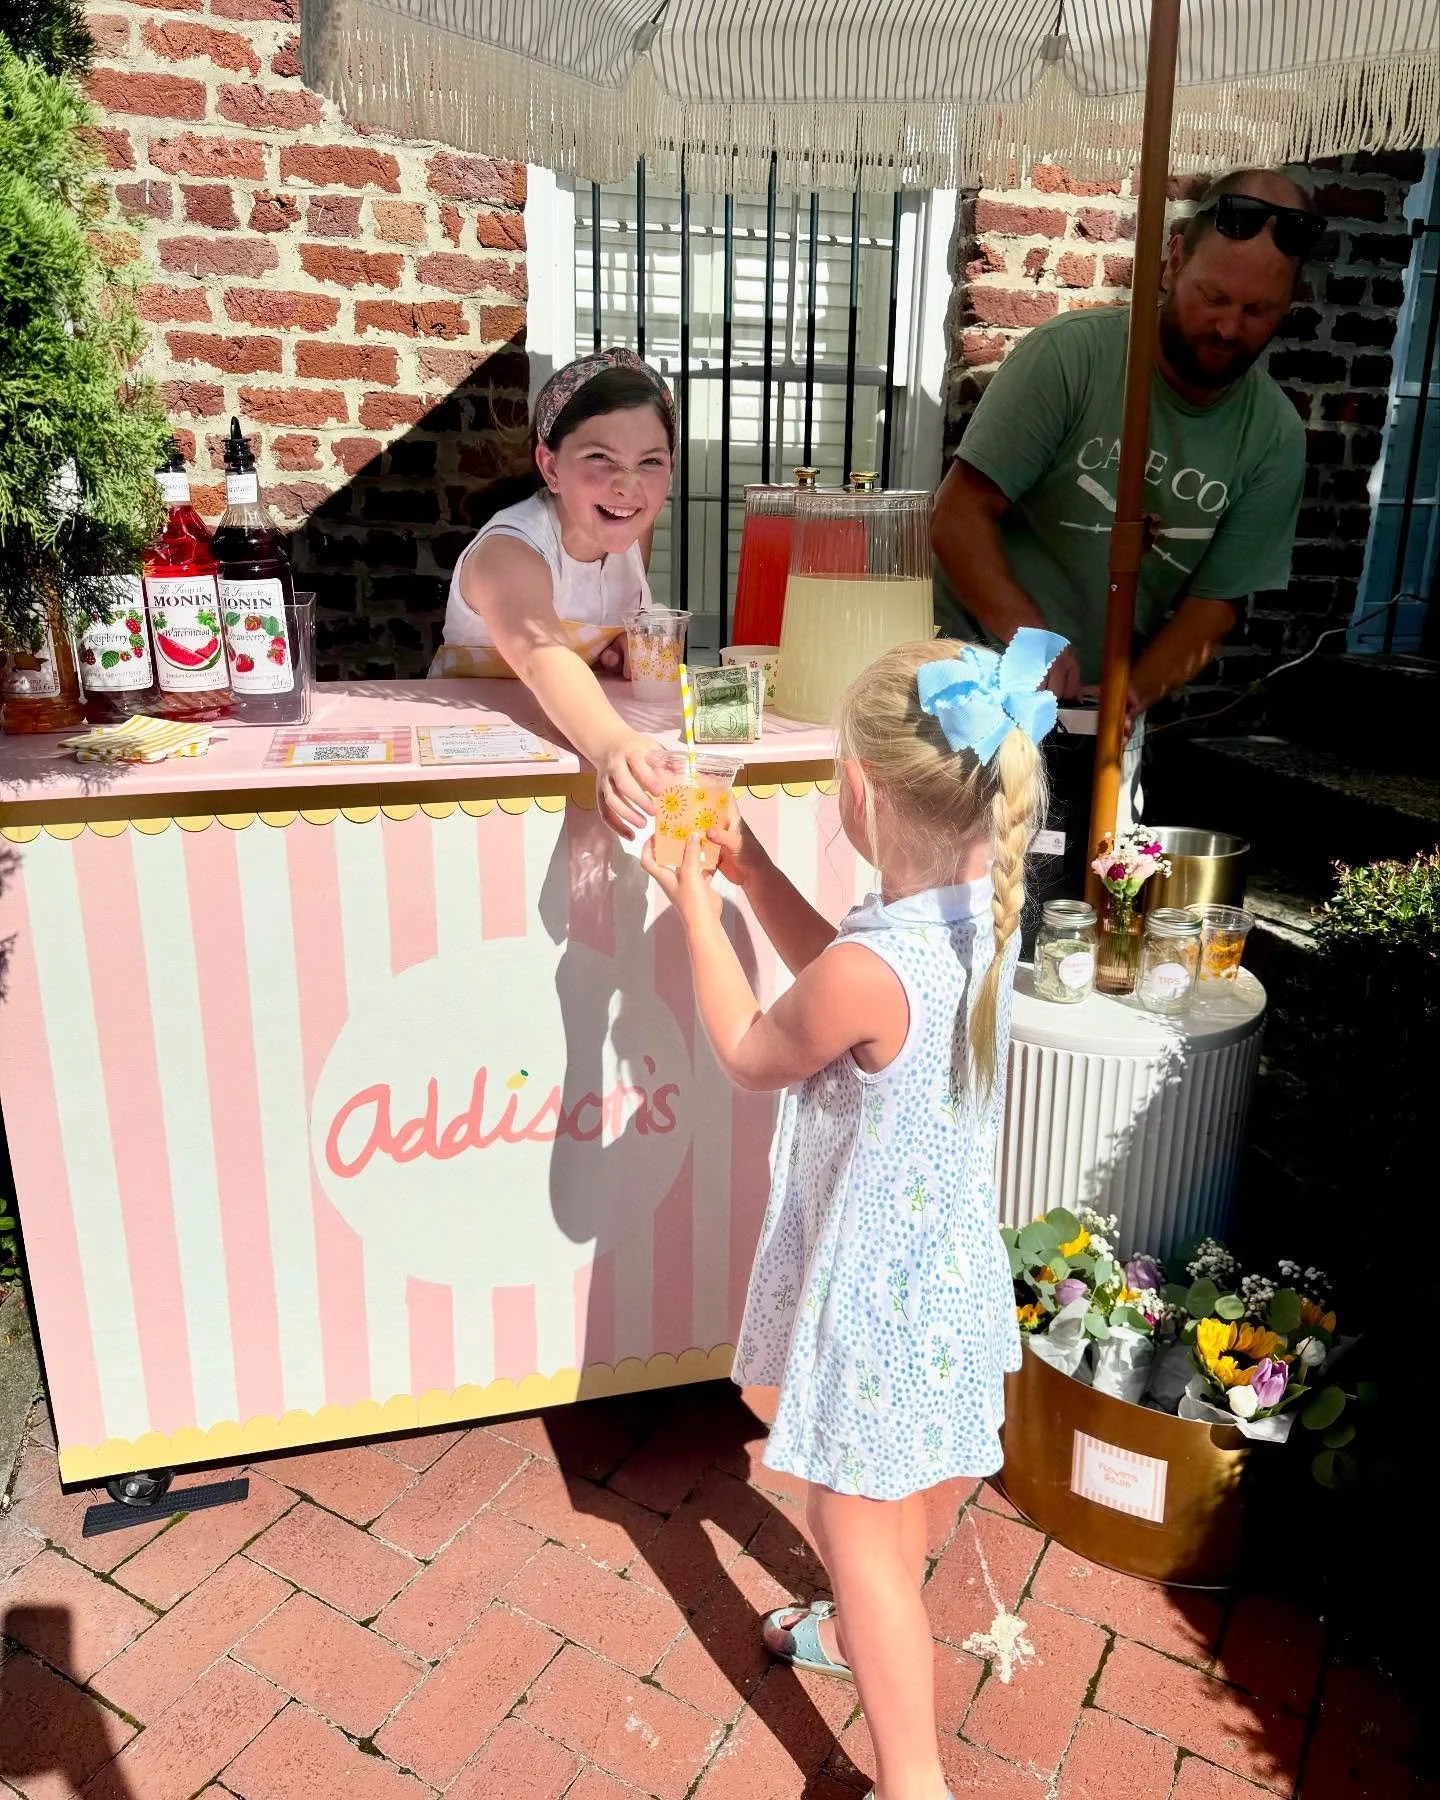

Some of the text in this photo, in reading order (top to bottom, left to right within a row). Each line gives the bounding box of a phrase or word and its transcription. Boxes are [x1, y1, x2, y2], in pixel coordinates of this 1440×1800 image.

[1077, 437, 1230, 519] CAE CO
[153, 593, 212, 607] MONIN
[162, 627, 210, 638] Watermelon
[88, 633, 127, 646] Raspberry
